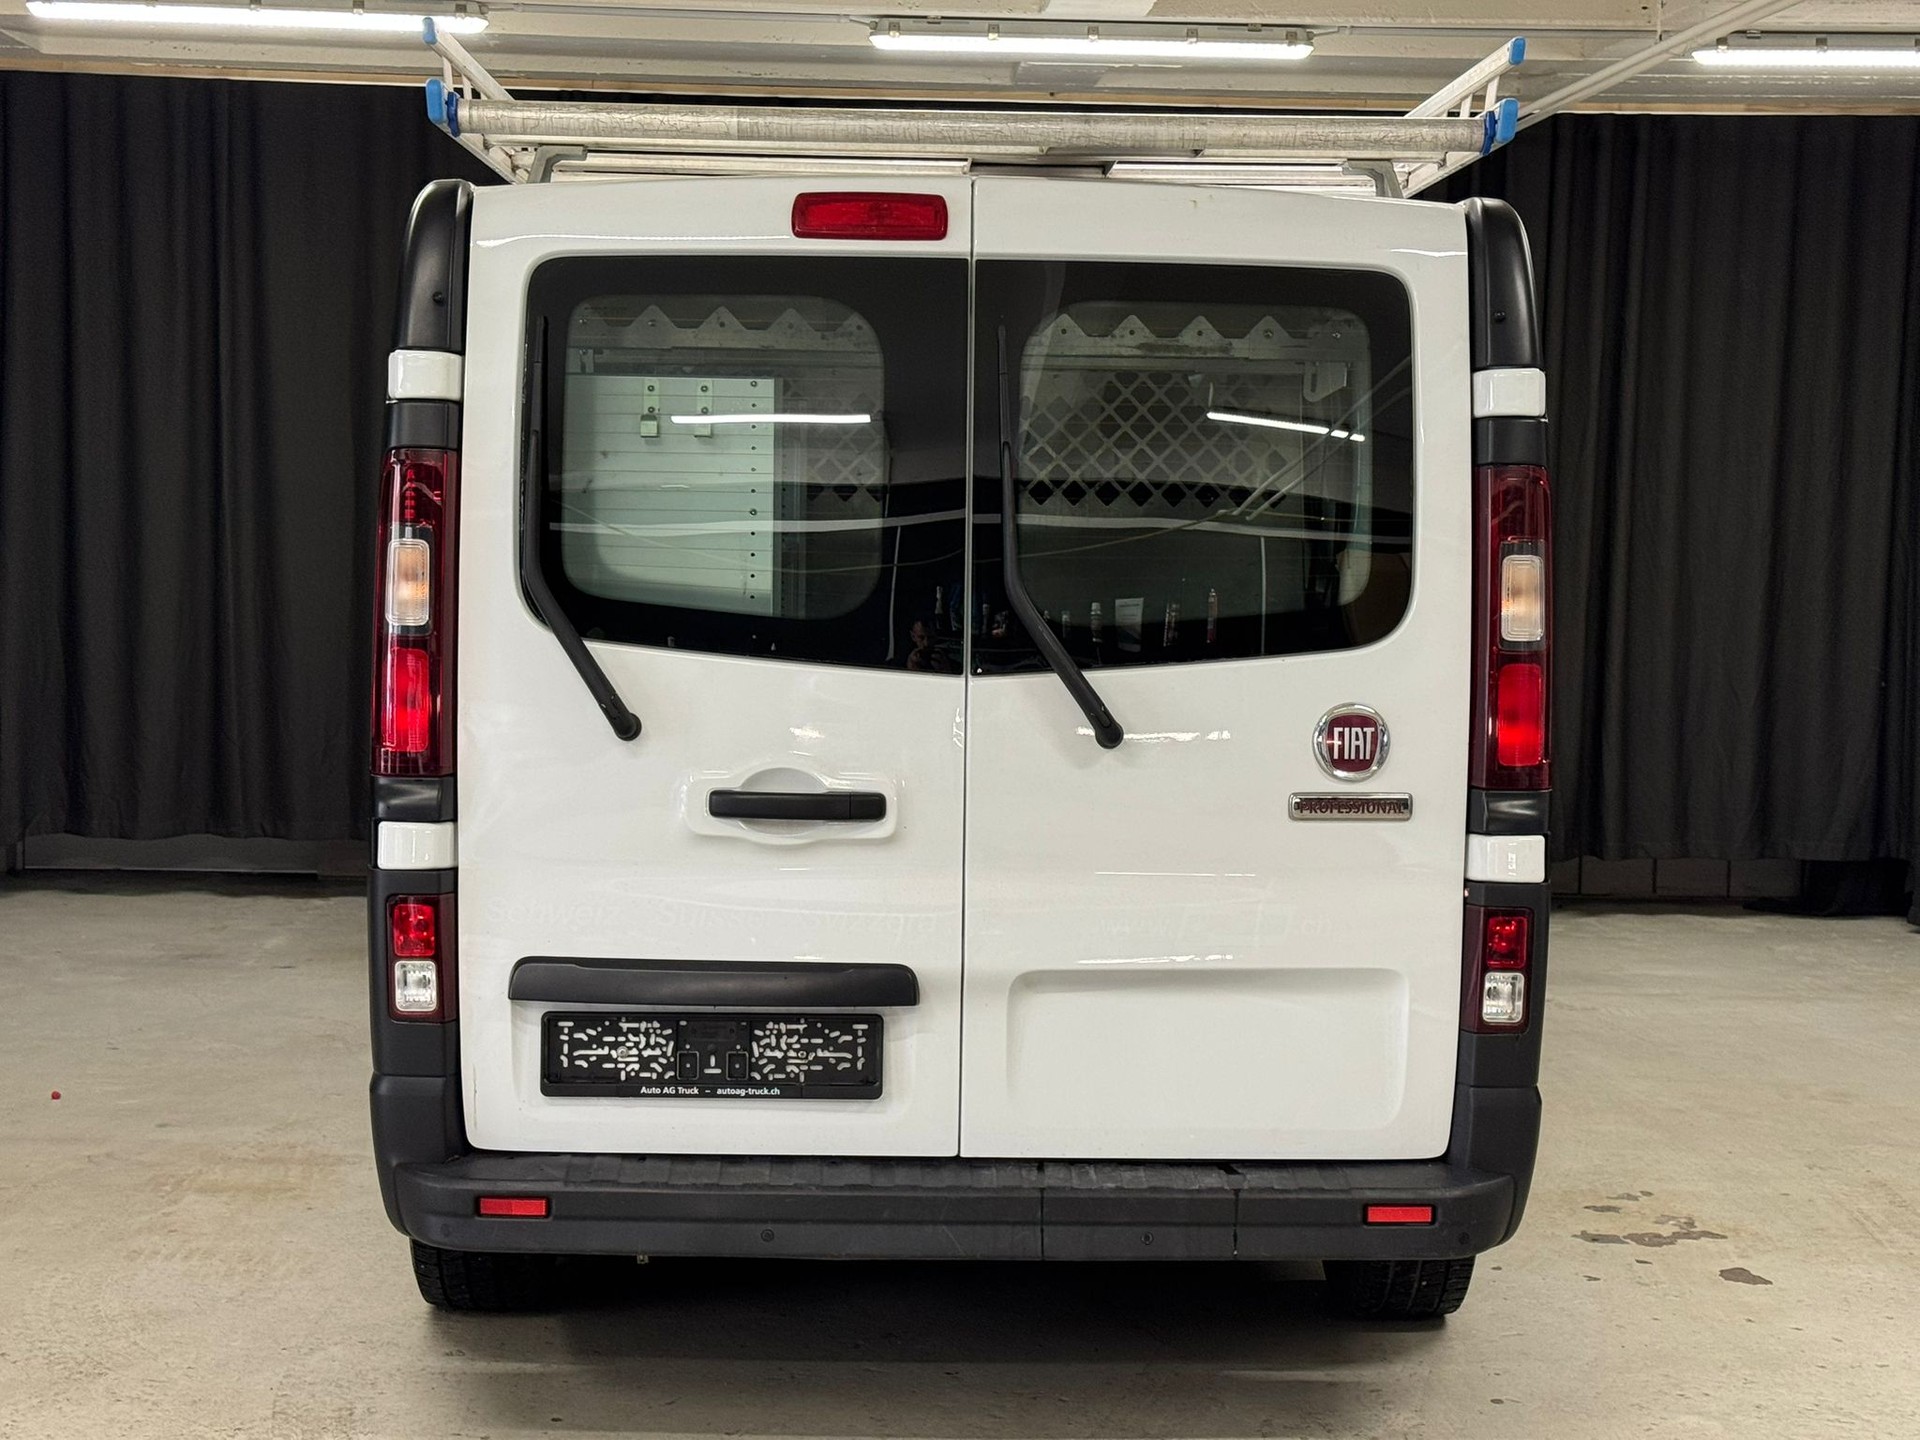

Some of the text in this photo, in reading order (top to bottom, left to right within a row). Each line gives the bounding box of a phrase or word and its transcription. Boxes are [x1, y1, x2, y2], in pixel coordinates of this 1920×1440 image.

[1333, 727, 1375, 760] FIAT
[1299, 800, 1405, 814] PROFESSIONAL
[640, 1086, 661, 1094] Auto
[662, 1086, 676, 1094] AG
[677, 1086, 699, 1094] Truck
[716, 1086, 780, 1096] autoag-truck.ch
